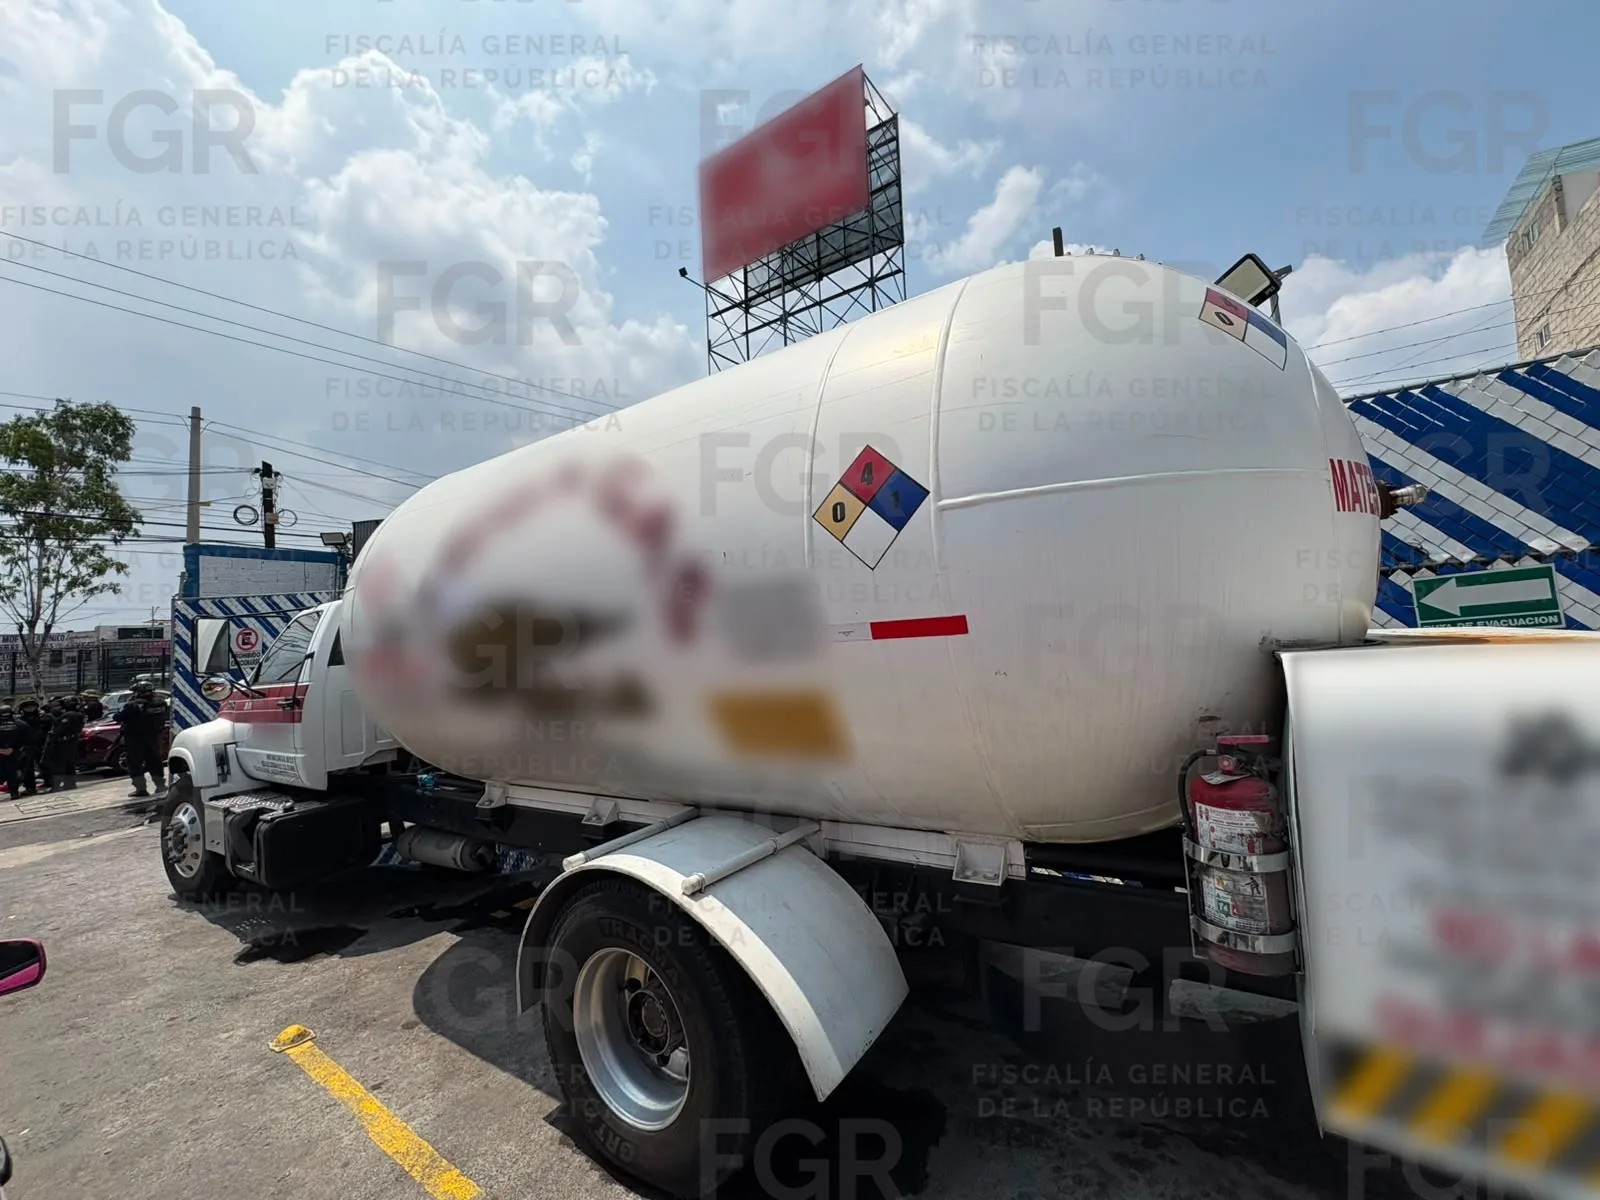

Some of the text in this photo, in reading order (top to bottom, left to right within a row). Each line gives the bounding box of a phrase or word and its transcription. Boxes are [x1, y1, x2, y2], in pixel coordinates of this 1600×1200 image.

[1214, 311, 1235, 326] 0
[861, 461, 874, 485] 4
[832, 501, 846, 523] 0
[891, 490, 899, 513] 1
[1476, 615, 1559, 628] EVACUACION
